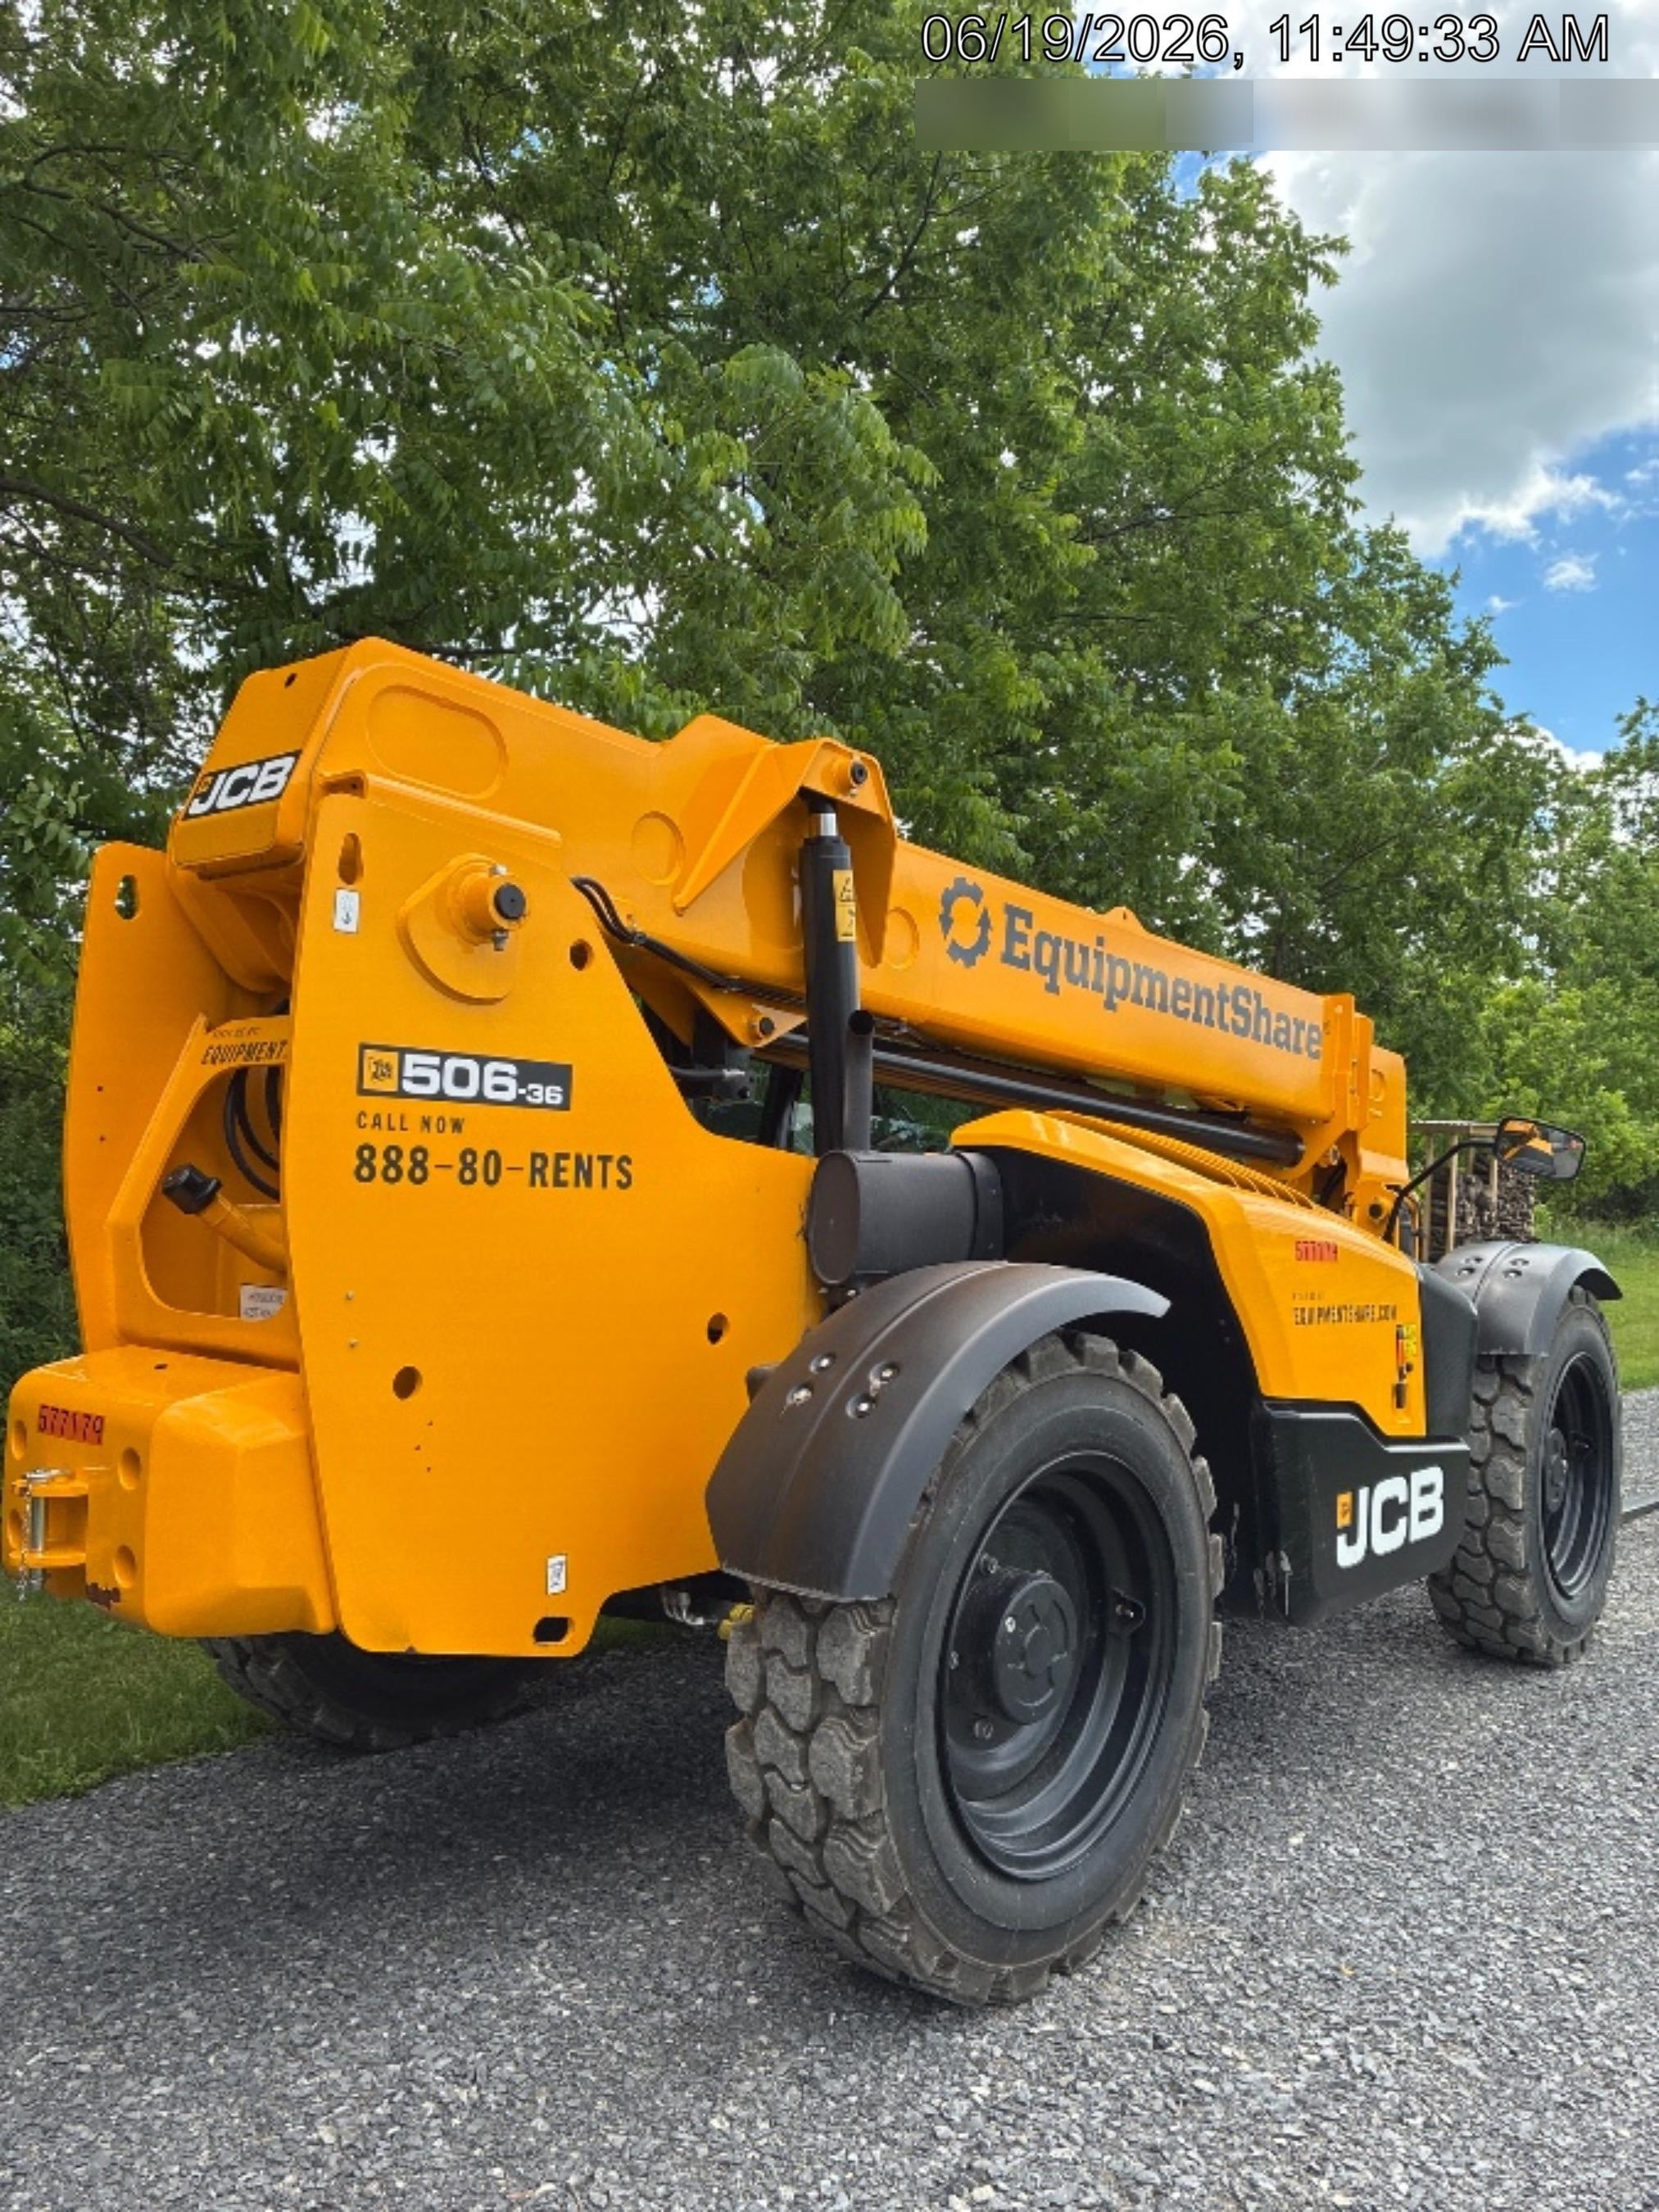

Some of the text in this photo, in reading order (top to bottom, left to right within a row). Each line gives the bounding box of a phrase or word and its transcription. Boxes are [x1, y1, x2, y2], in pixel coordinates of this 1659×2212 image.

[187, 755, 297, 816] JCB
[1000, 902, 1324, 1061] EquipmentShare
[401, 1053, 564, 1106] 506-36
[356, 1110, 465, 1135] CALL NOW
[354, 1142, 634, 1190] 888-80-RENTS
[39, 1403, 106, 1446] 577179
[1336, 1465, 1444, 1569] JCB
